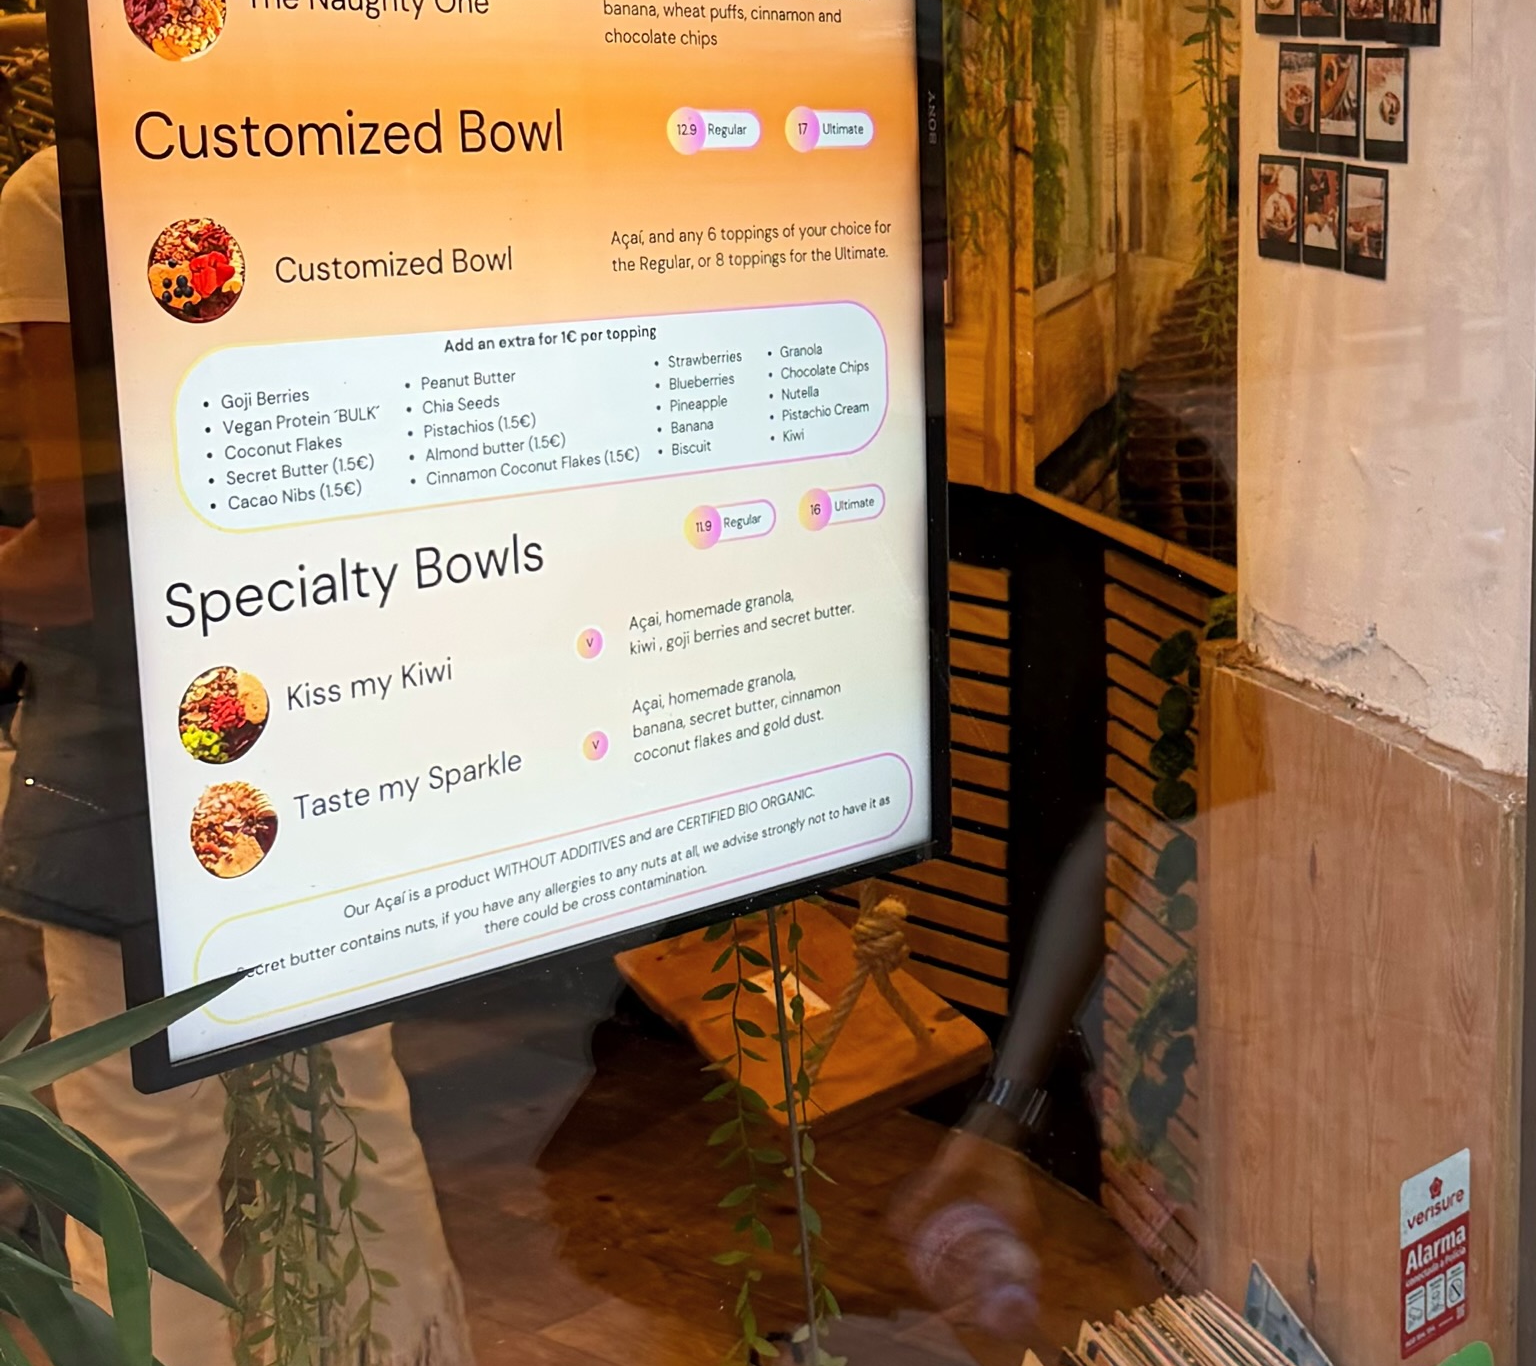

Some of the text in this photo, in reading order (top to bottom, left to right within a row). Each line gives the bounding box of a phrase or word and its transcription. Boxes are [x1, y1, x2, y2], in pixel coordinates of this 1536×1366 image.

[603, 0, 842, 23] banana, wheat puffs, cinnamon and
[604, 27, 718, 49] chocolate chips
[135, 108, 563, 160] Customized Bowl
[707, 123, 747, 139] Regular
[798, 122, 808, 135] 17
[822, 122, 864, 135] Ultimate
[610, 219, 892, 250] Açaí, and any 6 toppings of your choice for
[275, 245, 513, 283] Customized Bowl
[444, 337, 474, 353] Add
[477, 339, 495, 351] an
[498, 336, 535, 349] extra
[538, 332, 558, 345] for
[606, 325, 657, 343] topping
[668, 352, 743, 369] Strawberries
[779, 343, 823, 358] Granola
[780, 360, 870, 380] Chocolate Chips
[669, 373, 735, 391] Blueberries
[781, 385, 820, 401] Nutella
[221, 388, 310, 412] Goji Berries
[670, 394, 728, 412] Pineapple
[782, 403, 870, 421] Pistachio Cream
[222, 419, 273, 437] Vegan
[276, 411, 331, 430] Protein
[670, 420, 714, 435] Banana
[782, 428, 805, 442] Kiwi
[224, 436, 343, 460] Coconut Flakes
[671, 439, 711, 456] Biscuit
[226, 468, 278, 486] Secret
[281, 463, 329, 479] Butter
[228, 494, 278, 510] Cacao
[282, 487, 316, 504] Nibs
[810, 503, 822, 516] 16
[834, 498, 875, 512] Ultimate
[723, 513, 762, 530] Regular
[165, 533, 544, 638] Specialty Bowls
[287, 656, 452, 711] Kiss my Kiwi
[633, 709, 824, 763] coconut flakes and gold dust.
[293, 750, 522, 820] Taste my Sparkle
[343, 903, 371, 919] Our
[374, 890, 406, 912] Açaí
[408, 888, 420, 902] is
[424, 887, 432, 898] a
[435, 871, 490, 899] product
[493, 851, 557, 880] WITHOUT
[560, 834, 626, 863] ADDITIVES
[629, 827, 652, 845] and
[655, 824, 674, 838] are
[677, 806, 736, 832] CERTIFIED
[738, 800, 758, 817] BIO
[1407, 1188, 1465, 1230] verisure
[1405, 1225, 1466, 1275] Alarma
